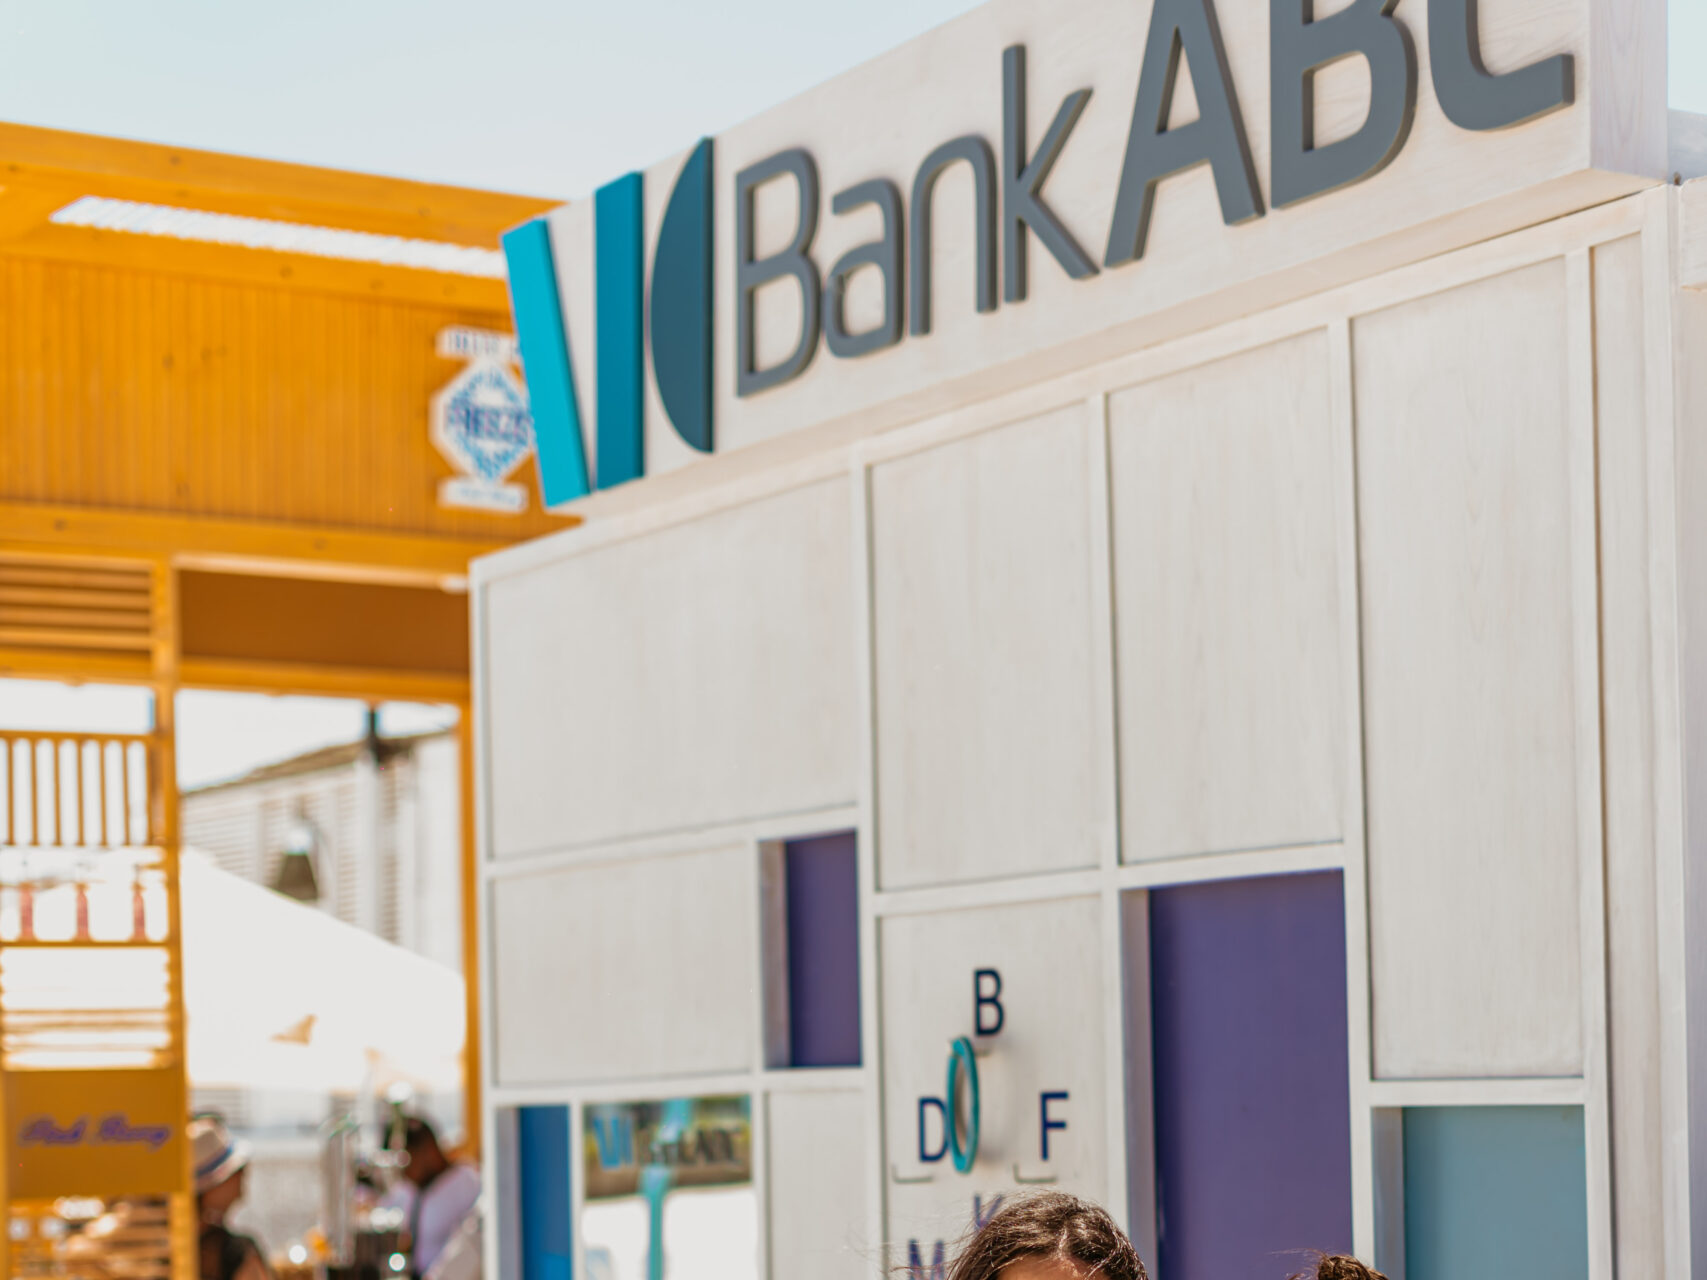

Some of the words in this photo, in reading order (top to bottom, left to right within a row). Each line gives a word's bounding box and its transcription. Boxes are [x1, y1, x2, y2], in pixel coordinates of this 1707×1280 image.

[973, 968, 1005, 1038] B
[917, 1096, 949, 1163] D
[1039, 1090, 1070, 1162] F
